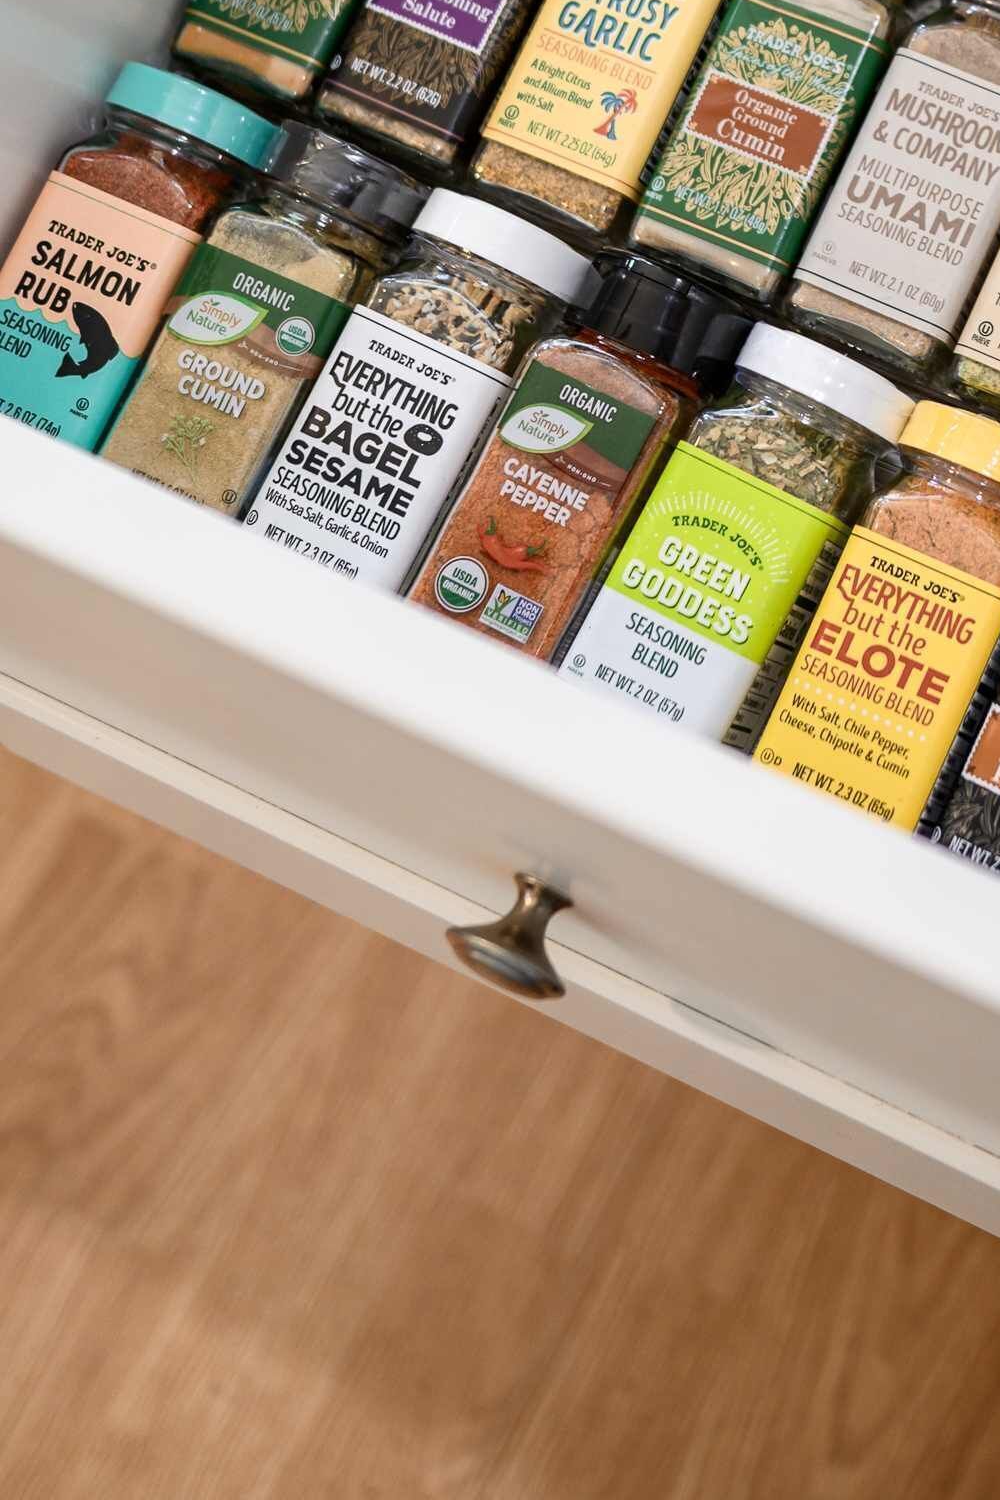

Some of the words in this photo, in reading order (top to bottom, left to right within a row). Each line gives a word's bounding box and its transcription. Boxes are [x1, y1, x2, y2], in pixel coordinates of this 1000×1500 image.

[558, 1, 662, 62] GARLIC
[747, 28, 801, 59] TRADER
[803, 49, 844, 72] JOE'S
[536, 34, 609, 75] SEASONING
[609, 63, 652, 90] BLEND
[539, 61, 565, 80] Bright
[566, 71, 591, 90] Citrus
[516, 90, 537, 104] with
[536, 96, 555, 113] Salt
[523, 75, 542, 89] and
[540, 80, 567, 100] Allium
[568, 91, 594, 109] Blend
[735, 90, 797, 125] Organic
[918, 81, 965, 107] TRADER
[968, 102, 1000, 122] JOE'S
[716, 118, 785, 161] Cumin
[732, 106, 788, 139] Ground
[873, 120, 888, 142] &
[894, 127, 1000, 186] COMPANY
[846, 175, 976, 248] UMAMI
[858, 155, 984, 221] MULTIPURPOSE
[48, 219, 104, 253] TRADER
[106, 247, 151, 272] JOE'S
[838, 202, 916, 248] SEASONING
[917, 235, 963, 266] BLEND
[14, 270, 72, 313] RUB
[31, 241, 141, 306] SALMON
[233, 272, 296, 312] ORGANIC
[0, 309, 72, 352] SEASONING
[186, 309, 227, 335] Nature
[200, 300, 241, 327] Simply
[177, 349, 266, 400] GROUND
[369, 340, 414, 369] TRADER
[416, 363, 452, 386] JOE'S
[178, 375, 248, 419] CUMIN
[330, 351, 459, 430] EVERYTHING
[332, 386, 373, 422] but
[372, 402, 403, 438] the
[559, 384, 618, 423] ORGANIC
[301, 406, 420, 489] BAGEL
[517, 420, 556, 445] Nature
[530, 411, 569, 438] Simply
[273, 466, 352, 518] SEASONING
[352, 506, 400, 540] BLEND
[286, 440, 414, 518] SESAME
[500, 480, 571, 528] PEPPER
[503, 458, 589, 512] CAYENNE
[266, 487, 288, 508] With
[287, 498, 304, 516] Sea
[303, 506, 324, 529] Salt,
[324, 519, 351, 543] Garlic
[351, 531, 360, 543] &
[360, 536, 389, 558] Onion
[672, 515, 728, 536] TRADER
[730, 534, 762, 567] JOE'S
[443, 579, 477, 602] ORGANIC
[452, 567, 478, 588] USDA
[658, 536, 750, 602] GREEN
[870, 556, 921, 586] TRADER
[923, 581, 960, 603] JOE'S
[485, 608, 529, 635] VERIFIED
[621, 559, 754, 645] GODDESS
[836, 564, 976, 645] EVERYTHING
[843, 599, 884, 639] but
[888, 623, 926, 656] the
[626, 612, 707, 665] SEASONING
[632, 642, 679, 680] BLEND
[809, 619, 950, 704] ELOTE
[801, 655, 885, 704] SEASONING
[885, 693, 935, 726] BLEND
[779, 709, 817, 738] Cheese,
[819, 728, 864, 758] Chipotle
[864, 750, 873, 762] &
[875, 754, 910, 779] Cumin
[791, 693, 817, 715] With
[817, 707, 842, 729] Salt,
[843, 718, 871, 740] Chile
[871, 730, 910, 760] Pepper,
